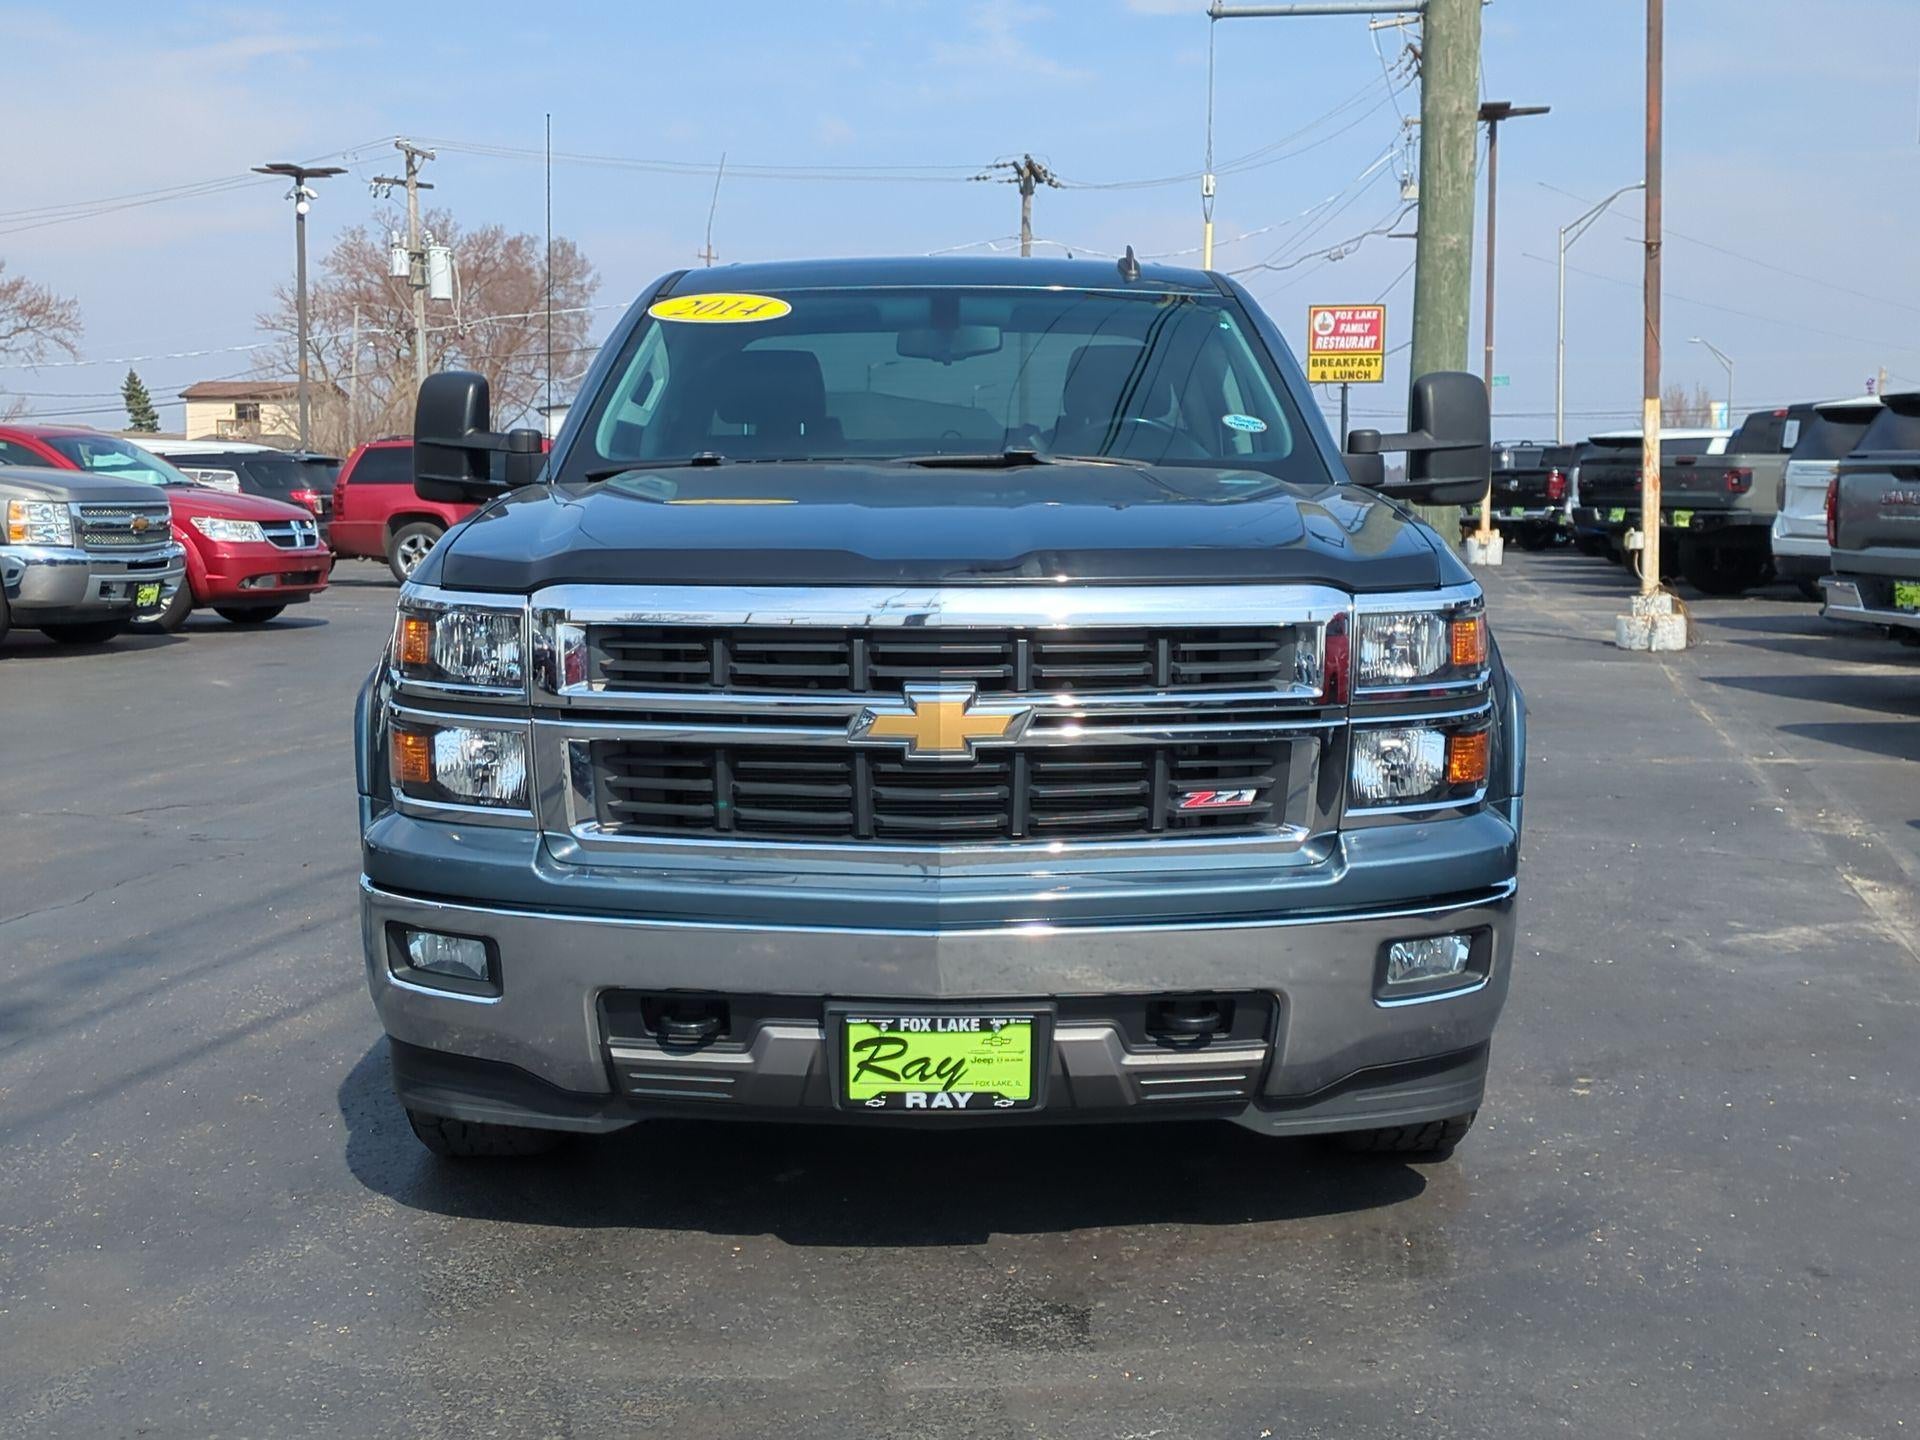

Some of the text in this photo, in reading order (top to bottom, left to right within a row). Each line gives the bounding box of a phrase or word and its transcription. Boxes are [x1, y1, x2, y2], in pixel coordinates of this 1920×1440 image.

[667, 300, 774, 316] 2014
[1335, 310, 1378, 320] FOX LAKE
[1340, 323, 1370, 333] FAMILY
[1315, 336, 1377, 349] RESTAURANT
[1311, 358, 1380, 367] BREAKFAST
[1320, 370, 1371, 380] & LUNCH
[1180, 789, 1257, 808] Z71
[900, 1018, 980, 1032] FOX LAKE
[853, 1036, 968, 1091] Ray
[971, 1056, 993, 1064] Jeep
[905, 1092, 974, 1109] RAY
